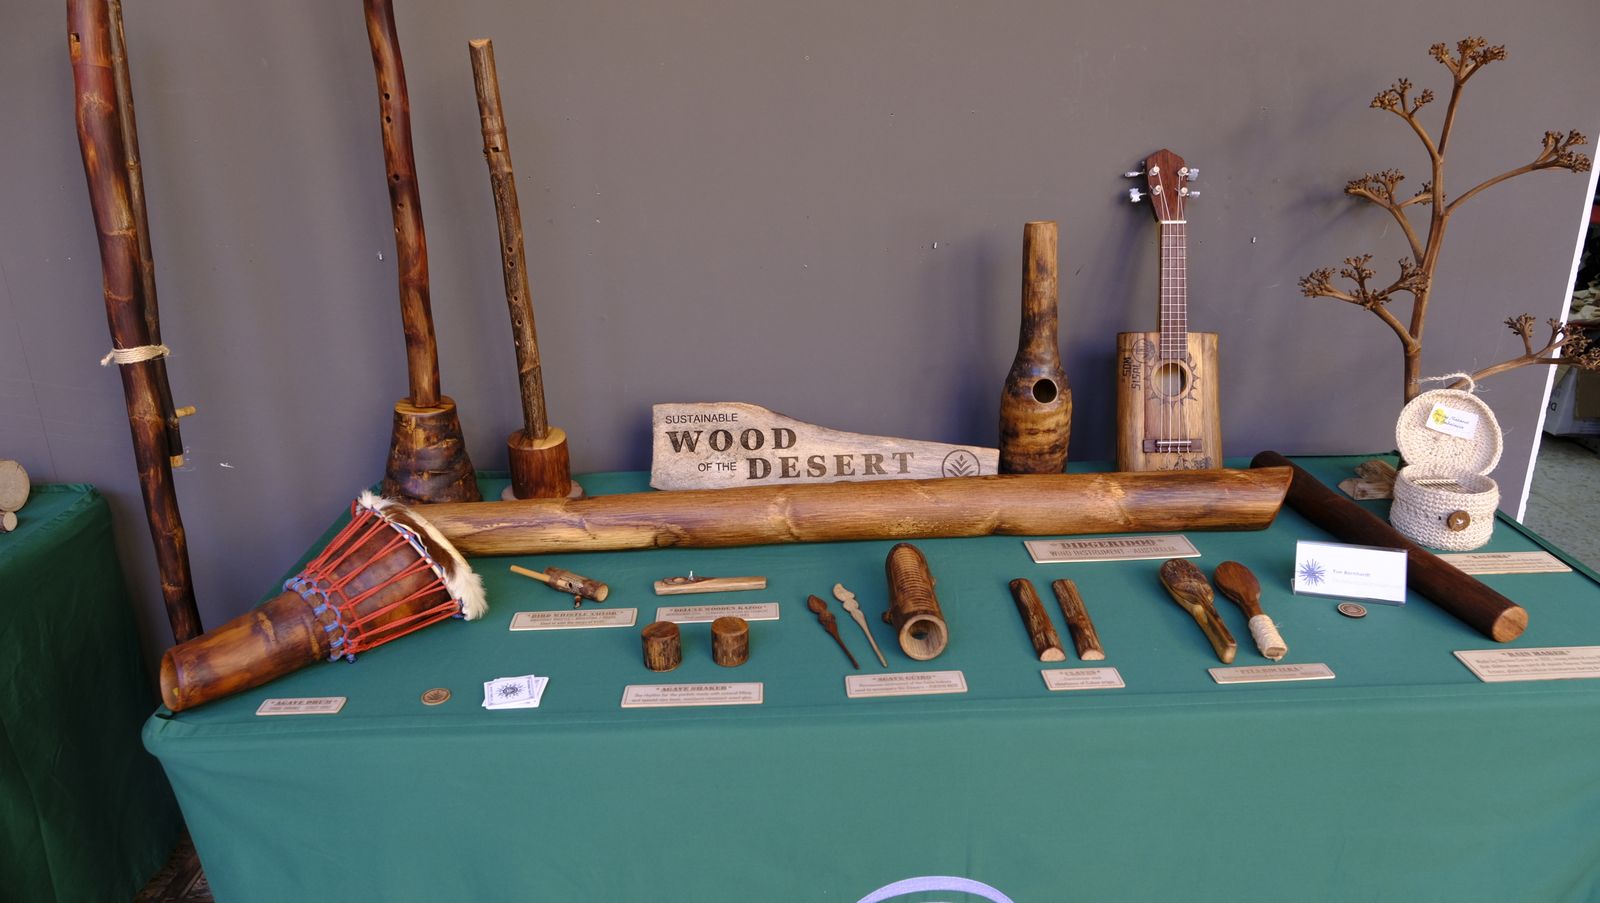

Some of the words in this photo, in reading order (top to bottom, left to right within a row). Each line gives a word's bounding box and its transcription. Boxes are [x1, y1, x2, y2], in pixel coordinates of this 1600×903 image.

[665, 413, 738, 424] SUSTAINABLE
[665, 427, 797, 453] WOOD
[697, 462, 713, 472] OF
[715, 461, 737, 471] THE
[746, 452, 914, 480] DESERT
